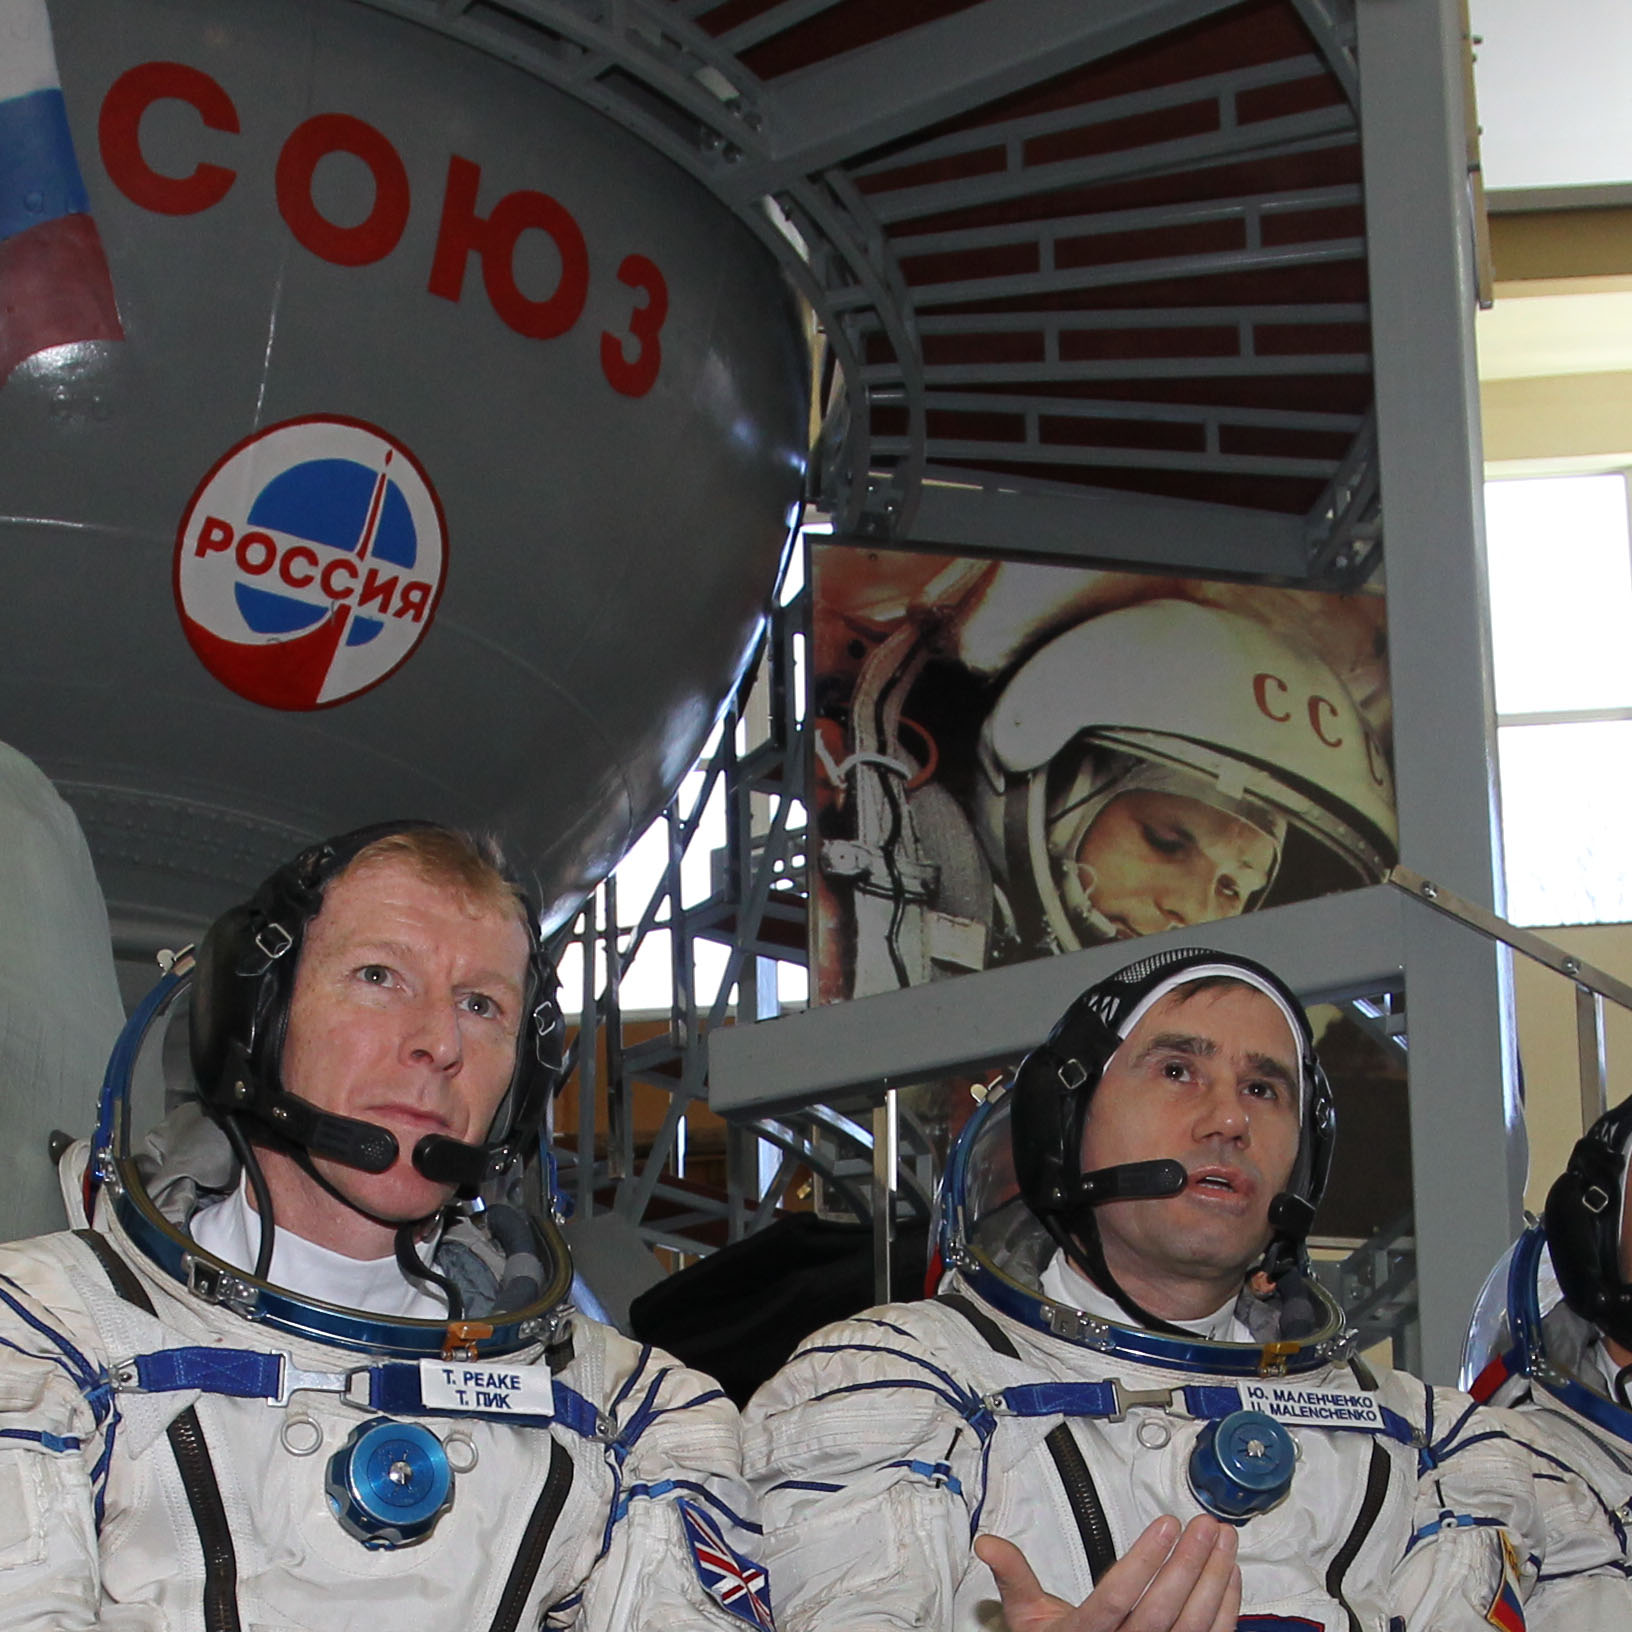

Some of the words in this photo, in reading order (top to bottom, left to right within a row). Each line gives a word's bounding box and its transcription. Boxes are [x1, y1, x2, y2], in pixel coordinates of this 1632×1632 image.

[98, 60, 669, 398] СОЮЗ
[194, 516, 434, 624] РОССИЯ
[442, 1369, 457, 1385] T.
[463, 1371, 521, 1391] PEAKE
[455, 1390, 469, 1406] Т.
[475, 1391, 512, 1409] ПИК
[1247, 1386, 1269, 1400] Ю.
[1273, 1389, 1374, 1408] МАЛЕНЧЕНКО
[1269, 1402, 1377, 1422] MALENCHENKO
